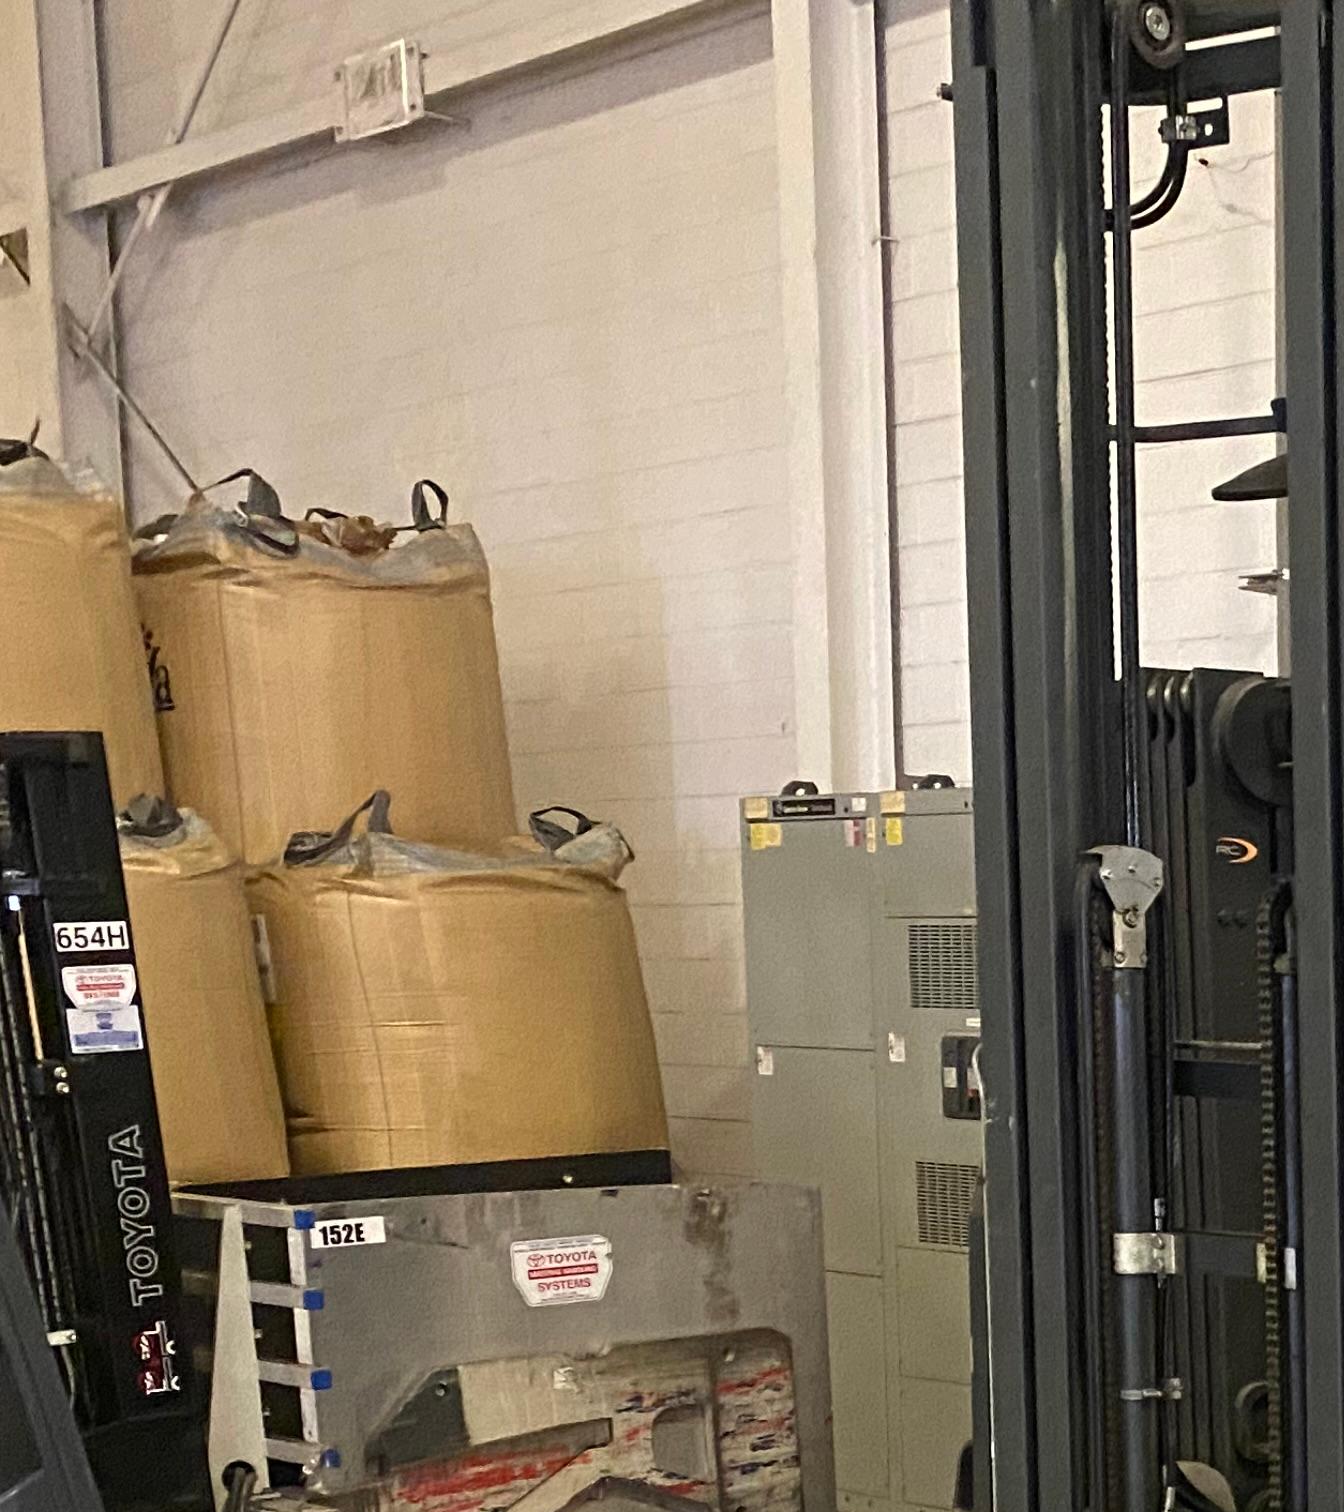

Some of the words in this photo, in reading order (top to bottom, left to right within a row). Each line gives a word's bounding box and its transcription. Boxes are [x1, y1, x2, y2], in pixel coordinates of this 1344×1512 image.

[57, 925, 126, 948] 654H
[108, 1125, 163, 1306] TOYOTA
[319, 1223, 366, 1245] 152E
[546, 1251, 597, 1264] TOYOTA
[538, 1278, 592, 1293] SYSTEMS
